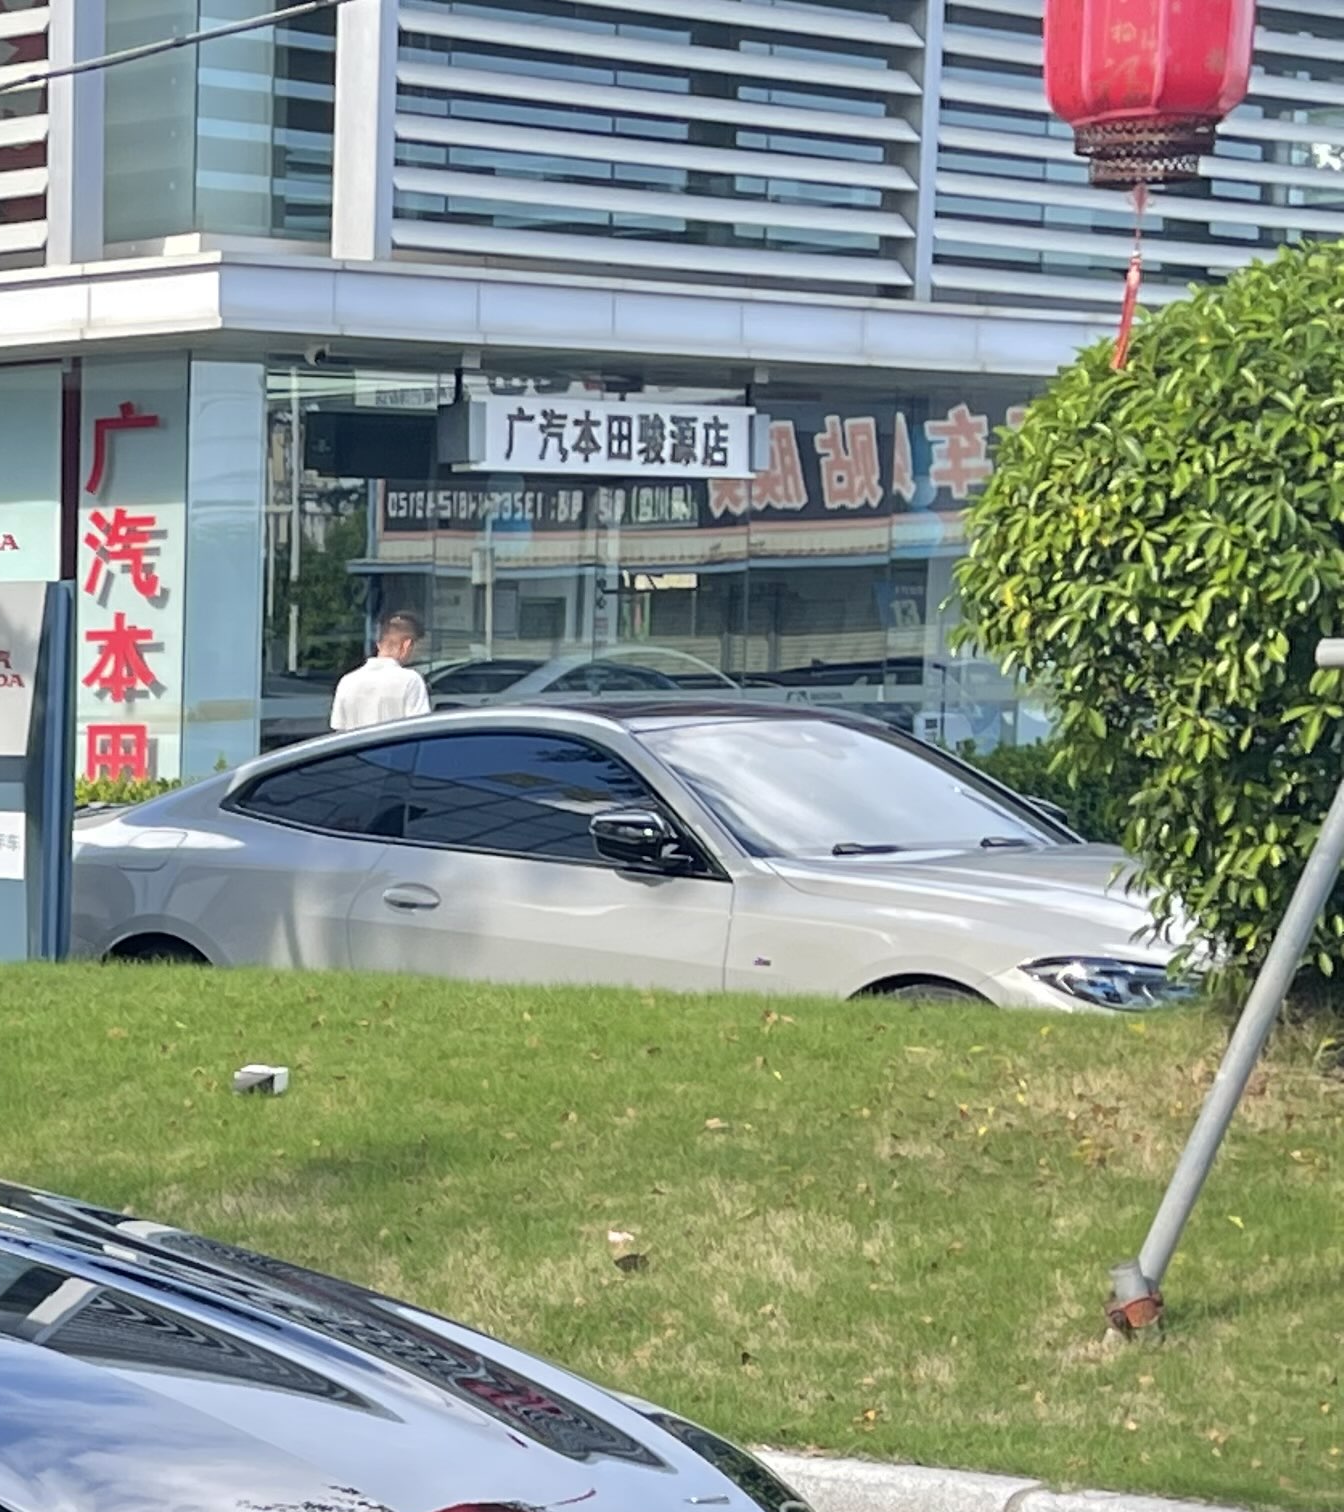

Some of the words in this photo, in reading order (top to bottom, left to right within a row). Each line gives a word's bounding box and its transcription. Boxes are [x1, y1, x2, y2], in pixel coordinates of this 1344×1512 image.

[505, 406, 729, 467] 广汽本田骏源店
